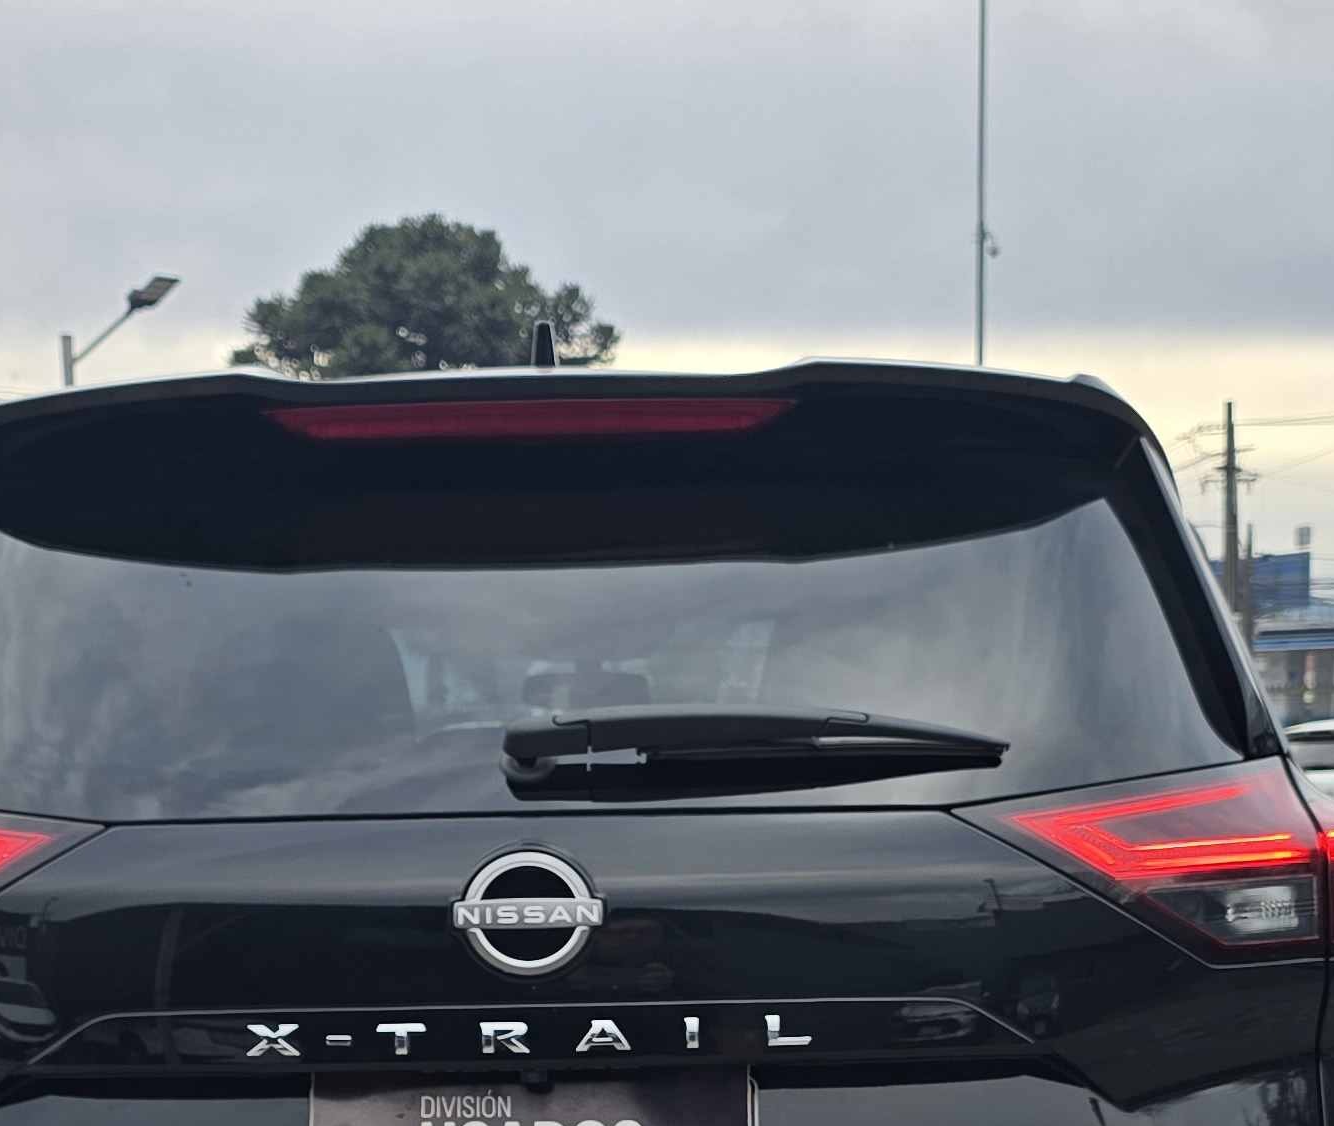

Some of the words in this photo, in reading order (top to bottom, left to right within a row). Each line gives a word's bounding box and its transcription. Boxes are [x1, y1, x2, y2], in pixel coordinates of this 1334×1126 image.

[457, 903, 601, 926] NISSAN
[246, 1015, 813, 1057] X-TRAIL
[420, 1089, 512, 1119] DIVISIÓN
